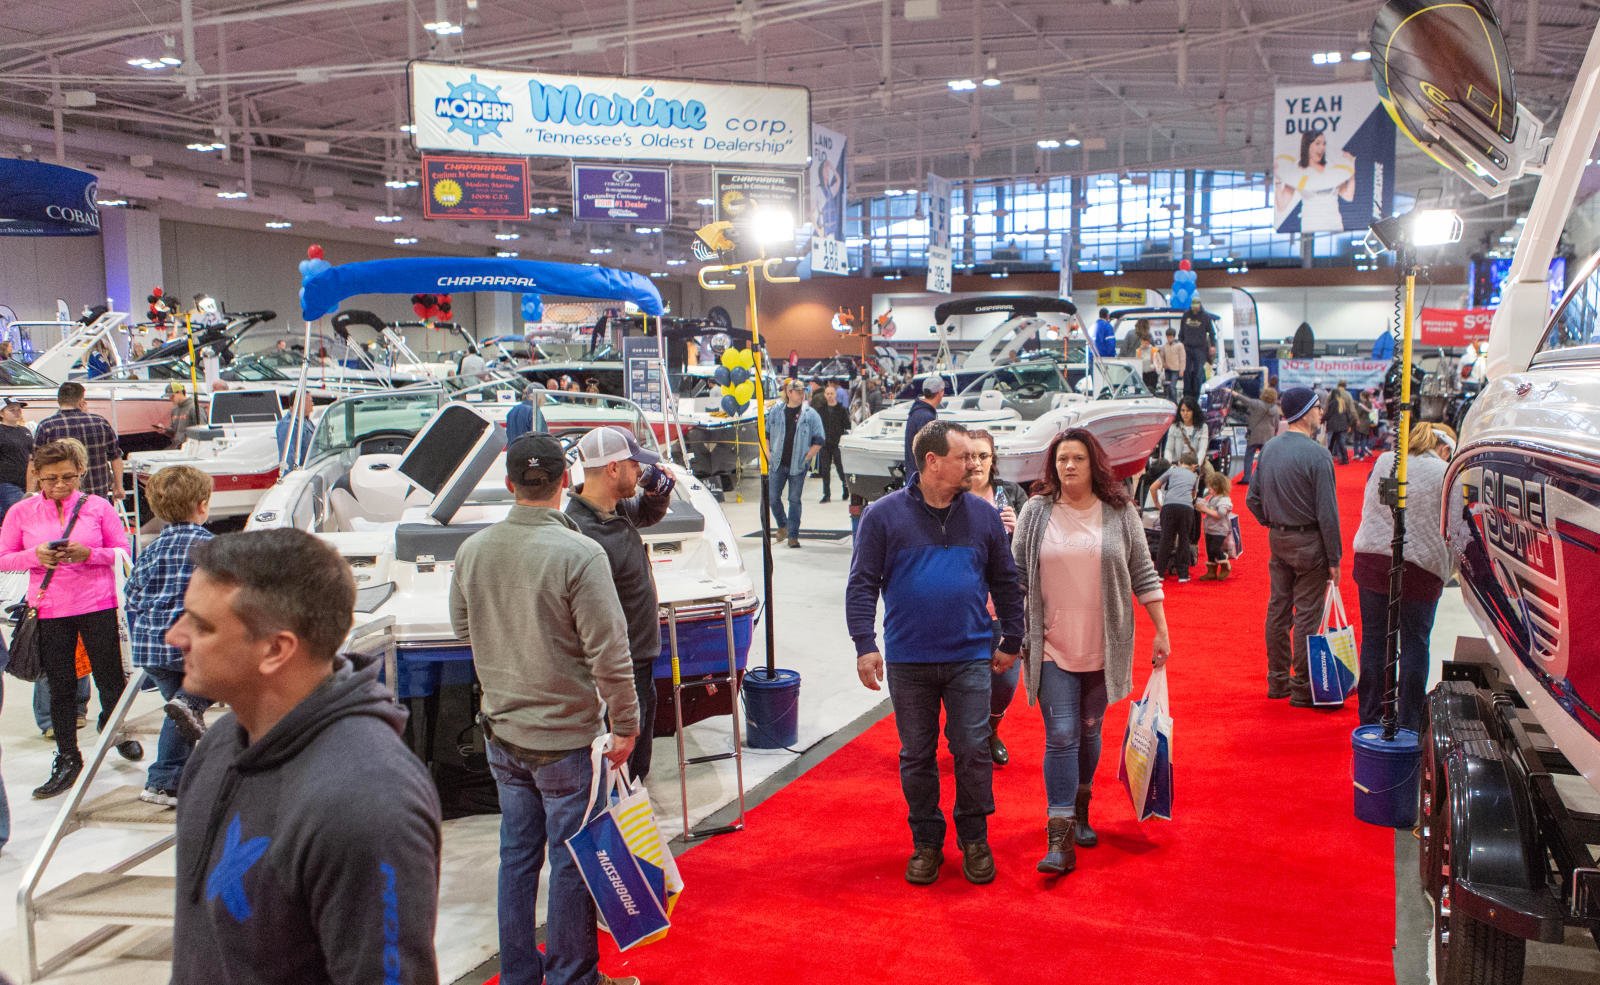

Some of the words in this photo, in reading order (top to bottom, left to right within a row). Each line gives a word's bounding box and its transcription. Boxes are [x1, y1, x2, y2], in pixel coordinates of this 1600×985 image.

[436, 98, 513, 122] MODERN
[528, 80, 708, 131] Marine
[726, 118, 793, 136] corp.
[1285, 95, 1342, 114] YEAH
[1286, 116, 1341, 135] BUOY
[526, 127, 632, 147] "Tennessee's
[641, 133, 694, 149] Oldest
[704, 137, 793, 155] Dealership"
[444, 163, 508, 172] CHAPARRAL
[732, 175, 786, 184] CHAPARRAL
[624, 200, 648, 208] Dealer
[437, 275, 537, 287] CHAPARRAL
[975, 304, 1015, 312] CHAPARRAL
[1314, 360, 1388, 372] Upholstery
[596, 849, 640, 917] PROGRESSIVE
